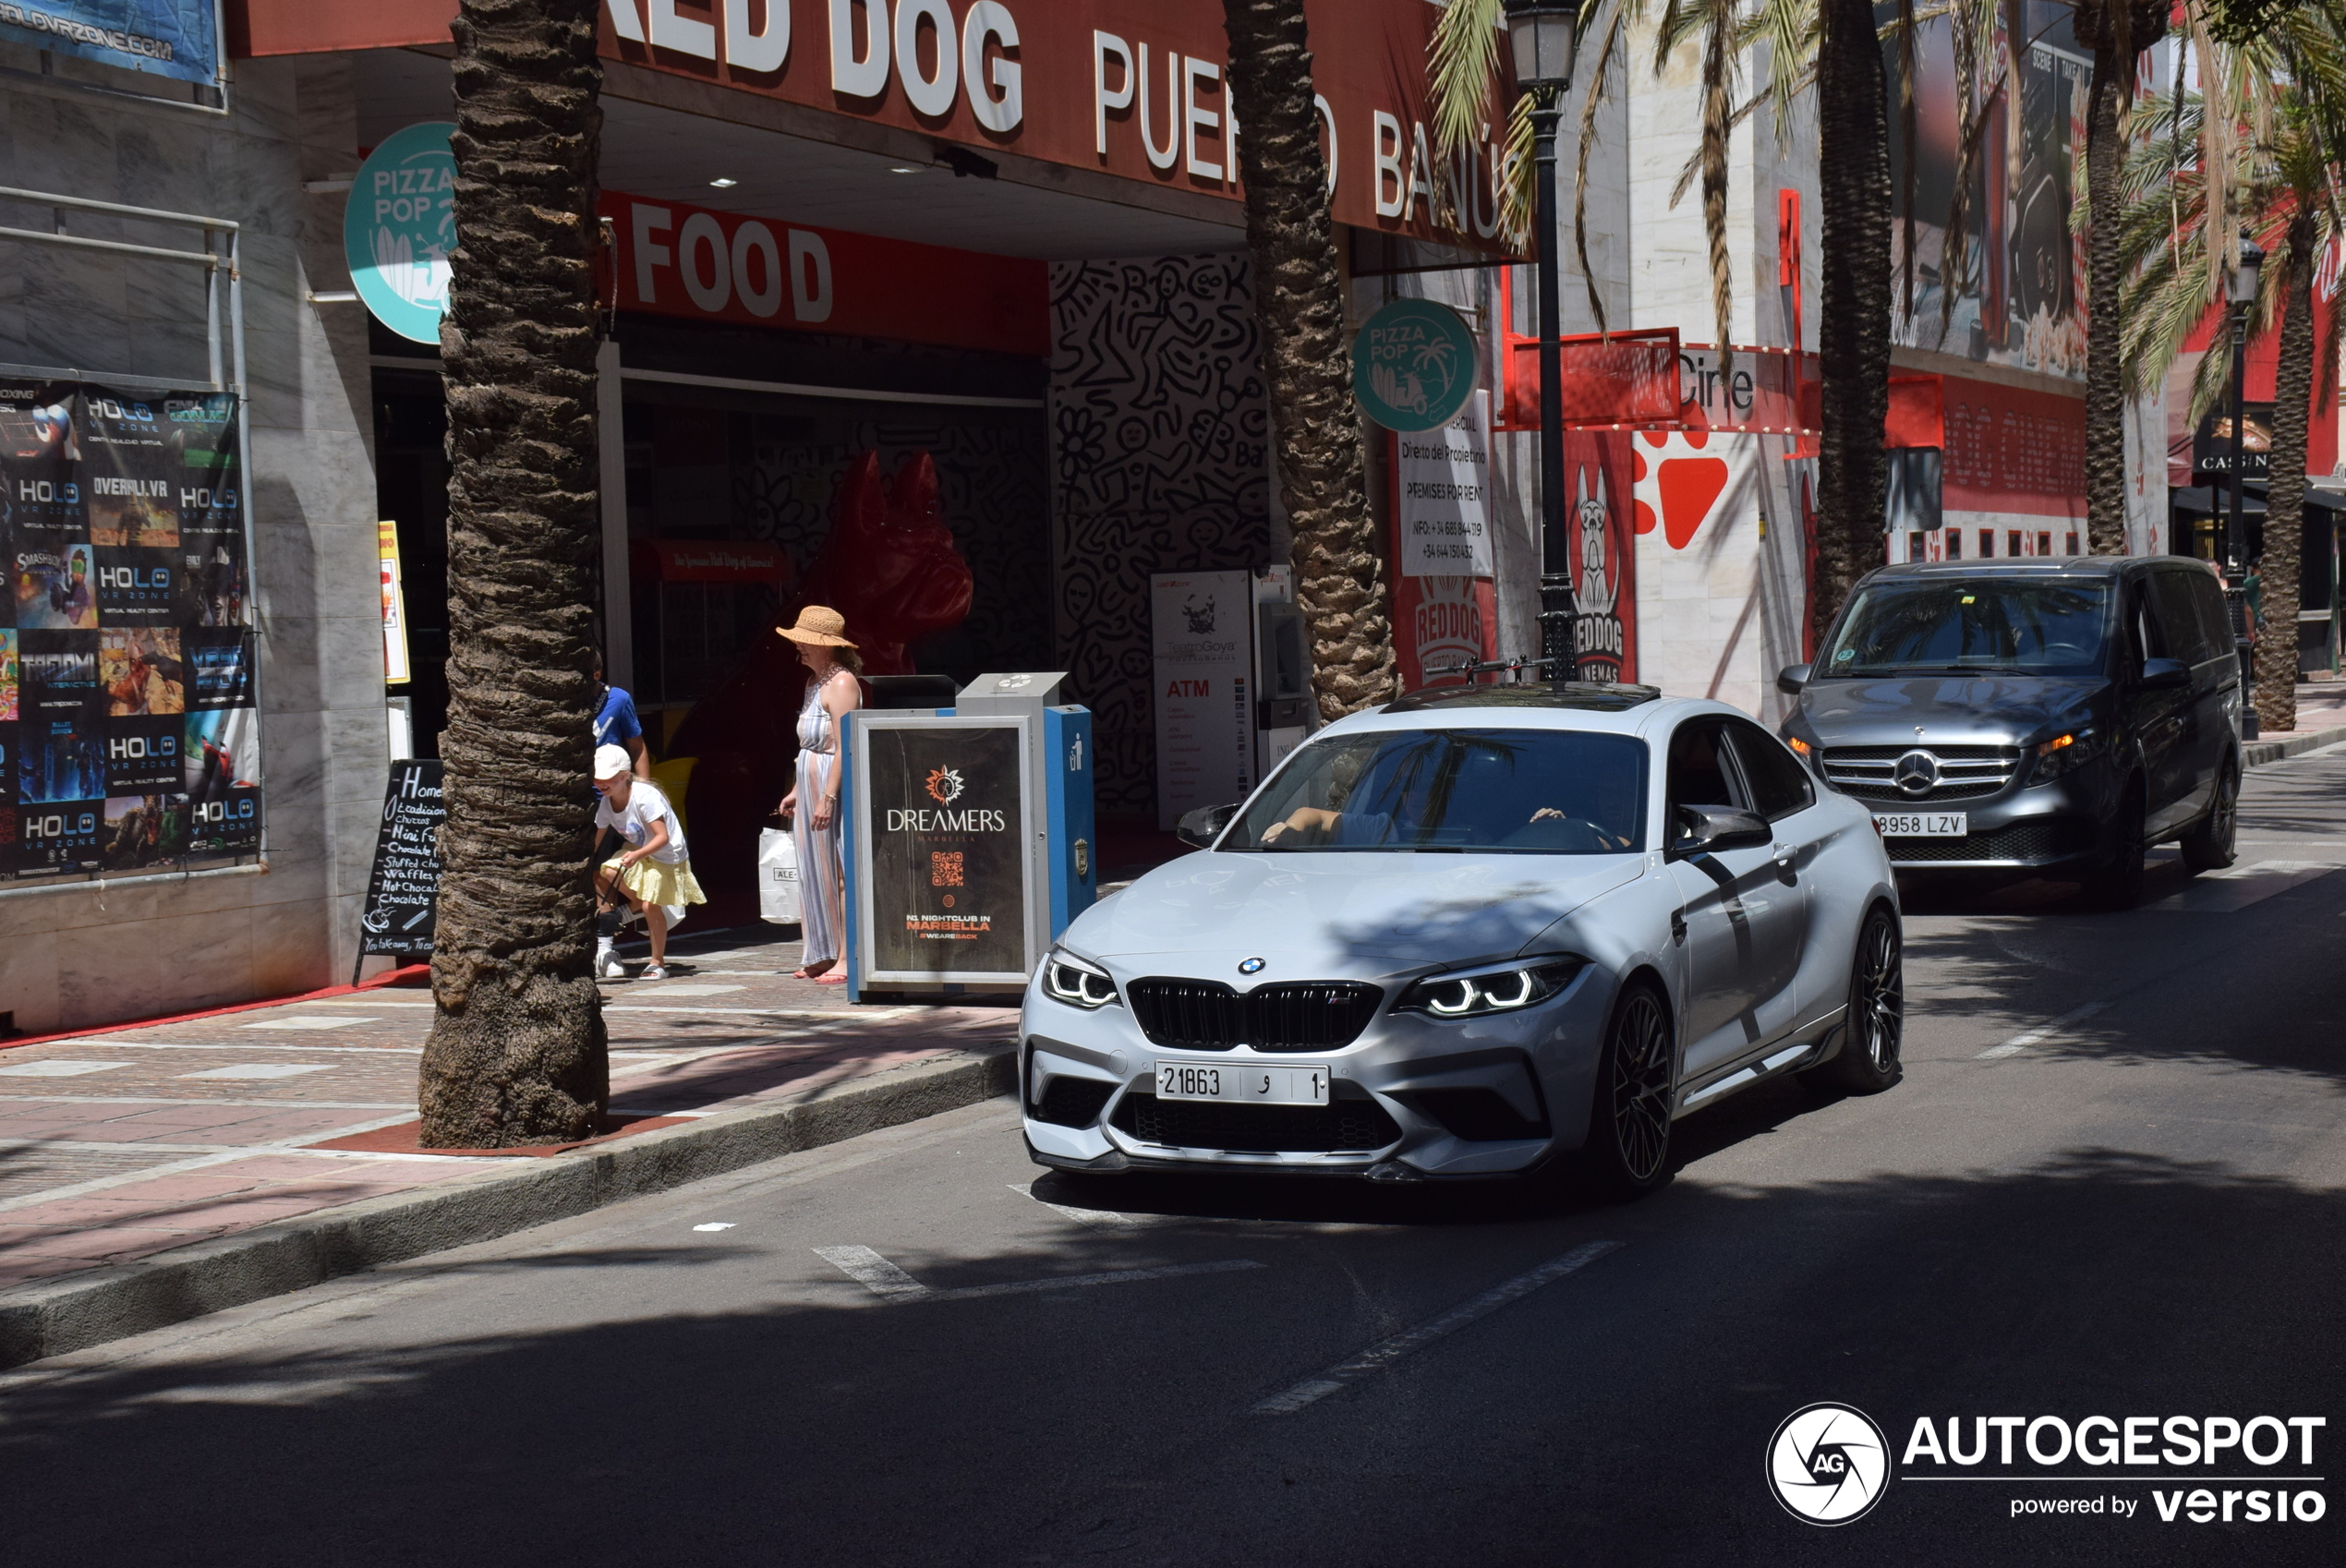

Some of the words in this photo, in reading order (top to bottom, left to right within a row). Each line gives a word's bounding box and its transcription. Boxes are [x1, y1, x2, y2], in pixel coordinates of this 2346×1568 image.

[830, 0, 1023, 133] DOG
[2033, 49, 2051, 72] SCENE
[375, 198, 431, 223] POP
[631, 203, 831, 322] FOOD
[1371, 326, 1425, 344] PIZZA
[1371, 344, 1409, 360] POP
[1679, 354, 1753, 409] Cine
[88, 397, 153, 422] HOLO
[119, 422, 159, 433] ZONE
[1402, 441, 1430, 460] Directo
[1432, 443, 1444, 460] del
[1445, 446, 1485, 465] Propietario
[19, 479, 79, 503] HOLO
[180, 488, 236, 508] HOLO
[1407, 482, 1445, 499] PREMISES
[1447, 484, 1463, 500] FOR
[1464, 485, 1483, 501] RENT
[21, 505, 39, 513] VR
[100, 567, 170, 588] HOLO
[1418, 602, 1446, 647] RED
[1450, 602, 1480, 645] DOG
[1573, 618, 1593, 654] ED
[1595, 617, 1623, 656] DOG
[1167, 641, 1235, 654] TeatroGoya
[1580, 664, 1618, 683] INEMAS
[1167, 680, 1210, 698] ATM
[110, 736, 175, 759] HOLO
[1277, 745, 1290, 757] ING
[140, 759, 176, 768] ZONE
[401, 766, 442, 799] Home
[192, 798, 254, 824] HOLO
[397, 802, 447, 815] tradicion
[25, 813, 95, 838] HOLO
[219, 822, 254, 832] ZONE
[887, 809, 1005, 831] DREAMERS
[1879, 816, 1920, 832] 8958
[1927, 816, 1960, 833] LZV
[25, 841, 43, 850] VR
[55, 838, 96, 848] ZONE
[383, 856, 417, 868] Stuffed
[422, 858, 439, 869] chu
[381, 880, 401, 891] Hot
[906, 922, 990, 931] MARBELLA
[1164, 1067, 1220, 1095] 21863
[1312, 1073, 1319, 1099] 1
